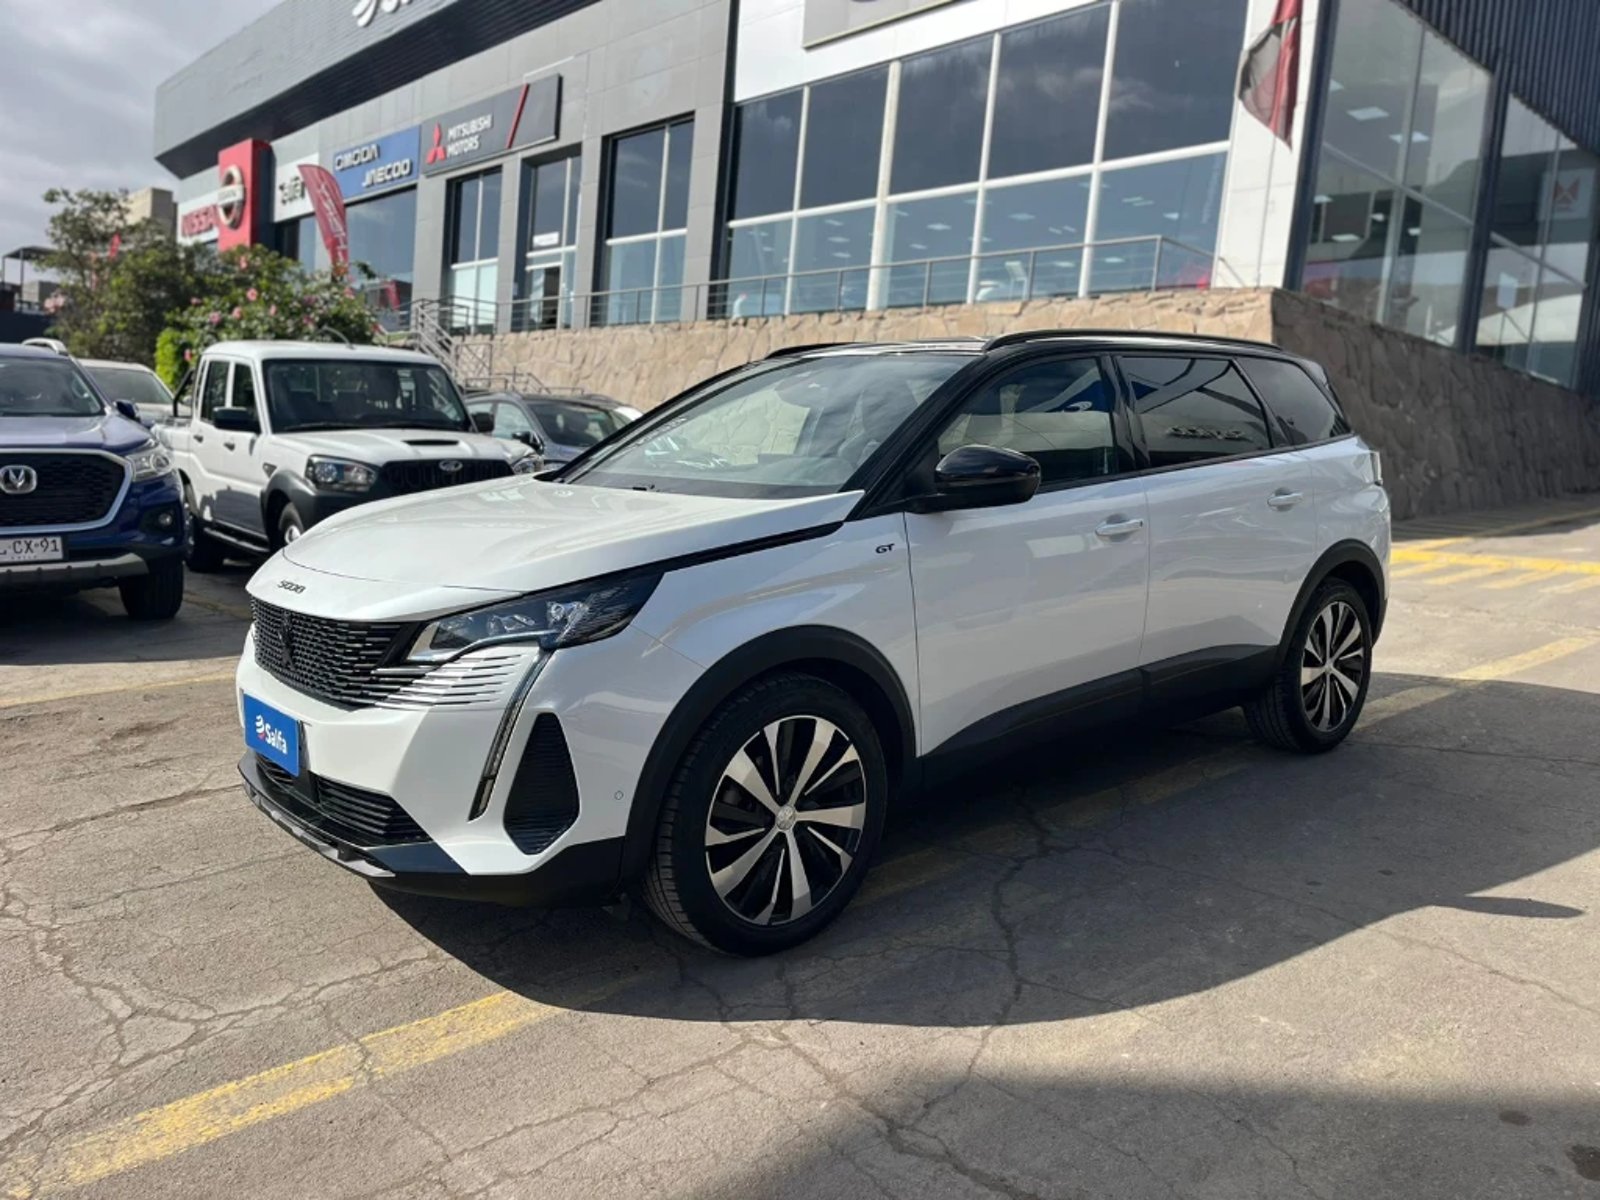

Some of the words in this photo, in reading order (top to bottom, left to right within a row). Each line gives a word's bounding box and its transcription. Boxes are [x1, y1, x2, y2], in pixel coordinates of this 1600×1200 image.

[447, 114, 493, 141] MITSUBISHI
[446, 134, 480, 158] MOTORS
[182, 204, 218, 237] NISSA
[875, 543, 895, 554] GT
[265, 722, 288, 755] Salfa
